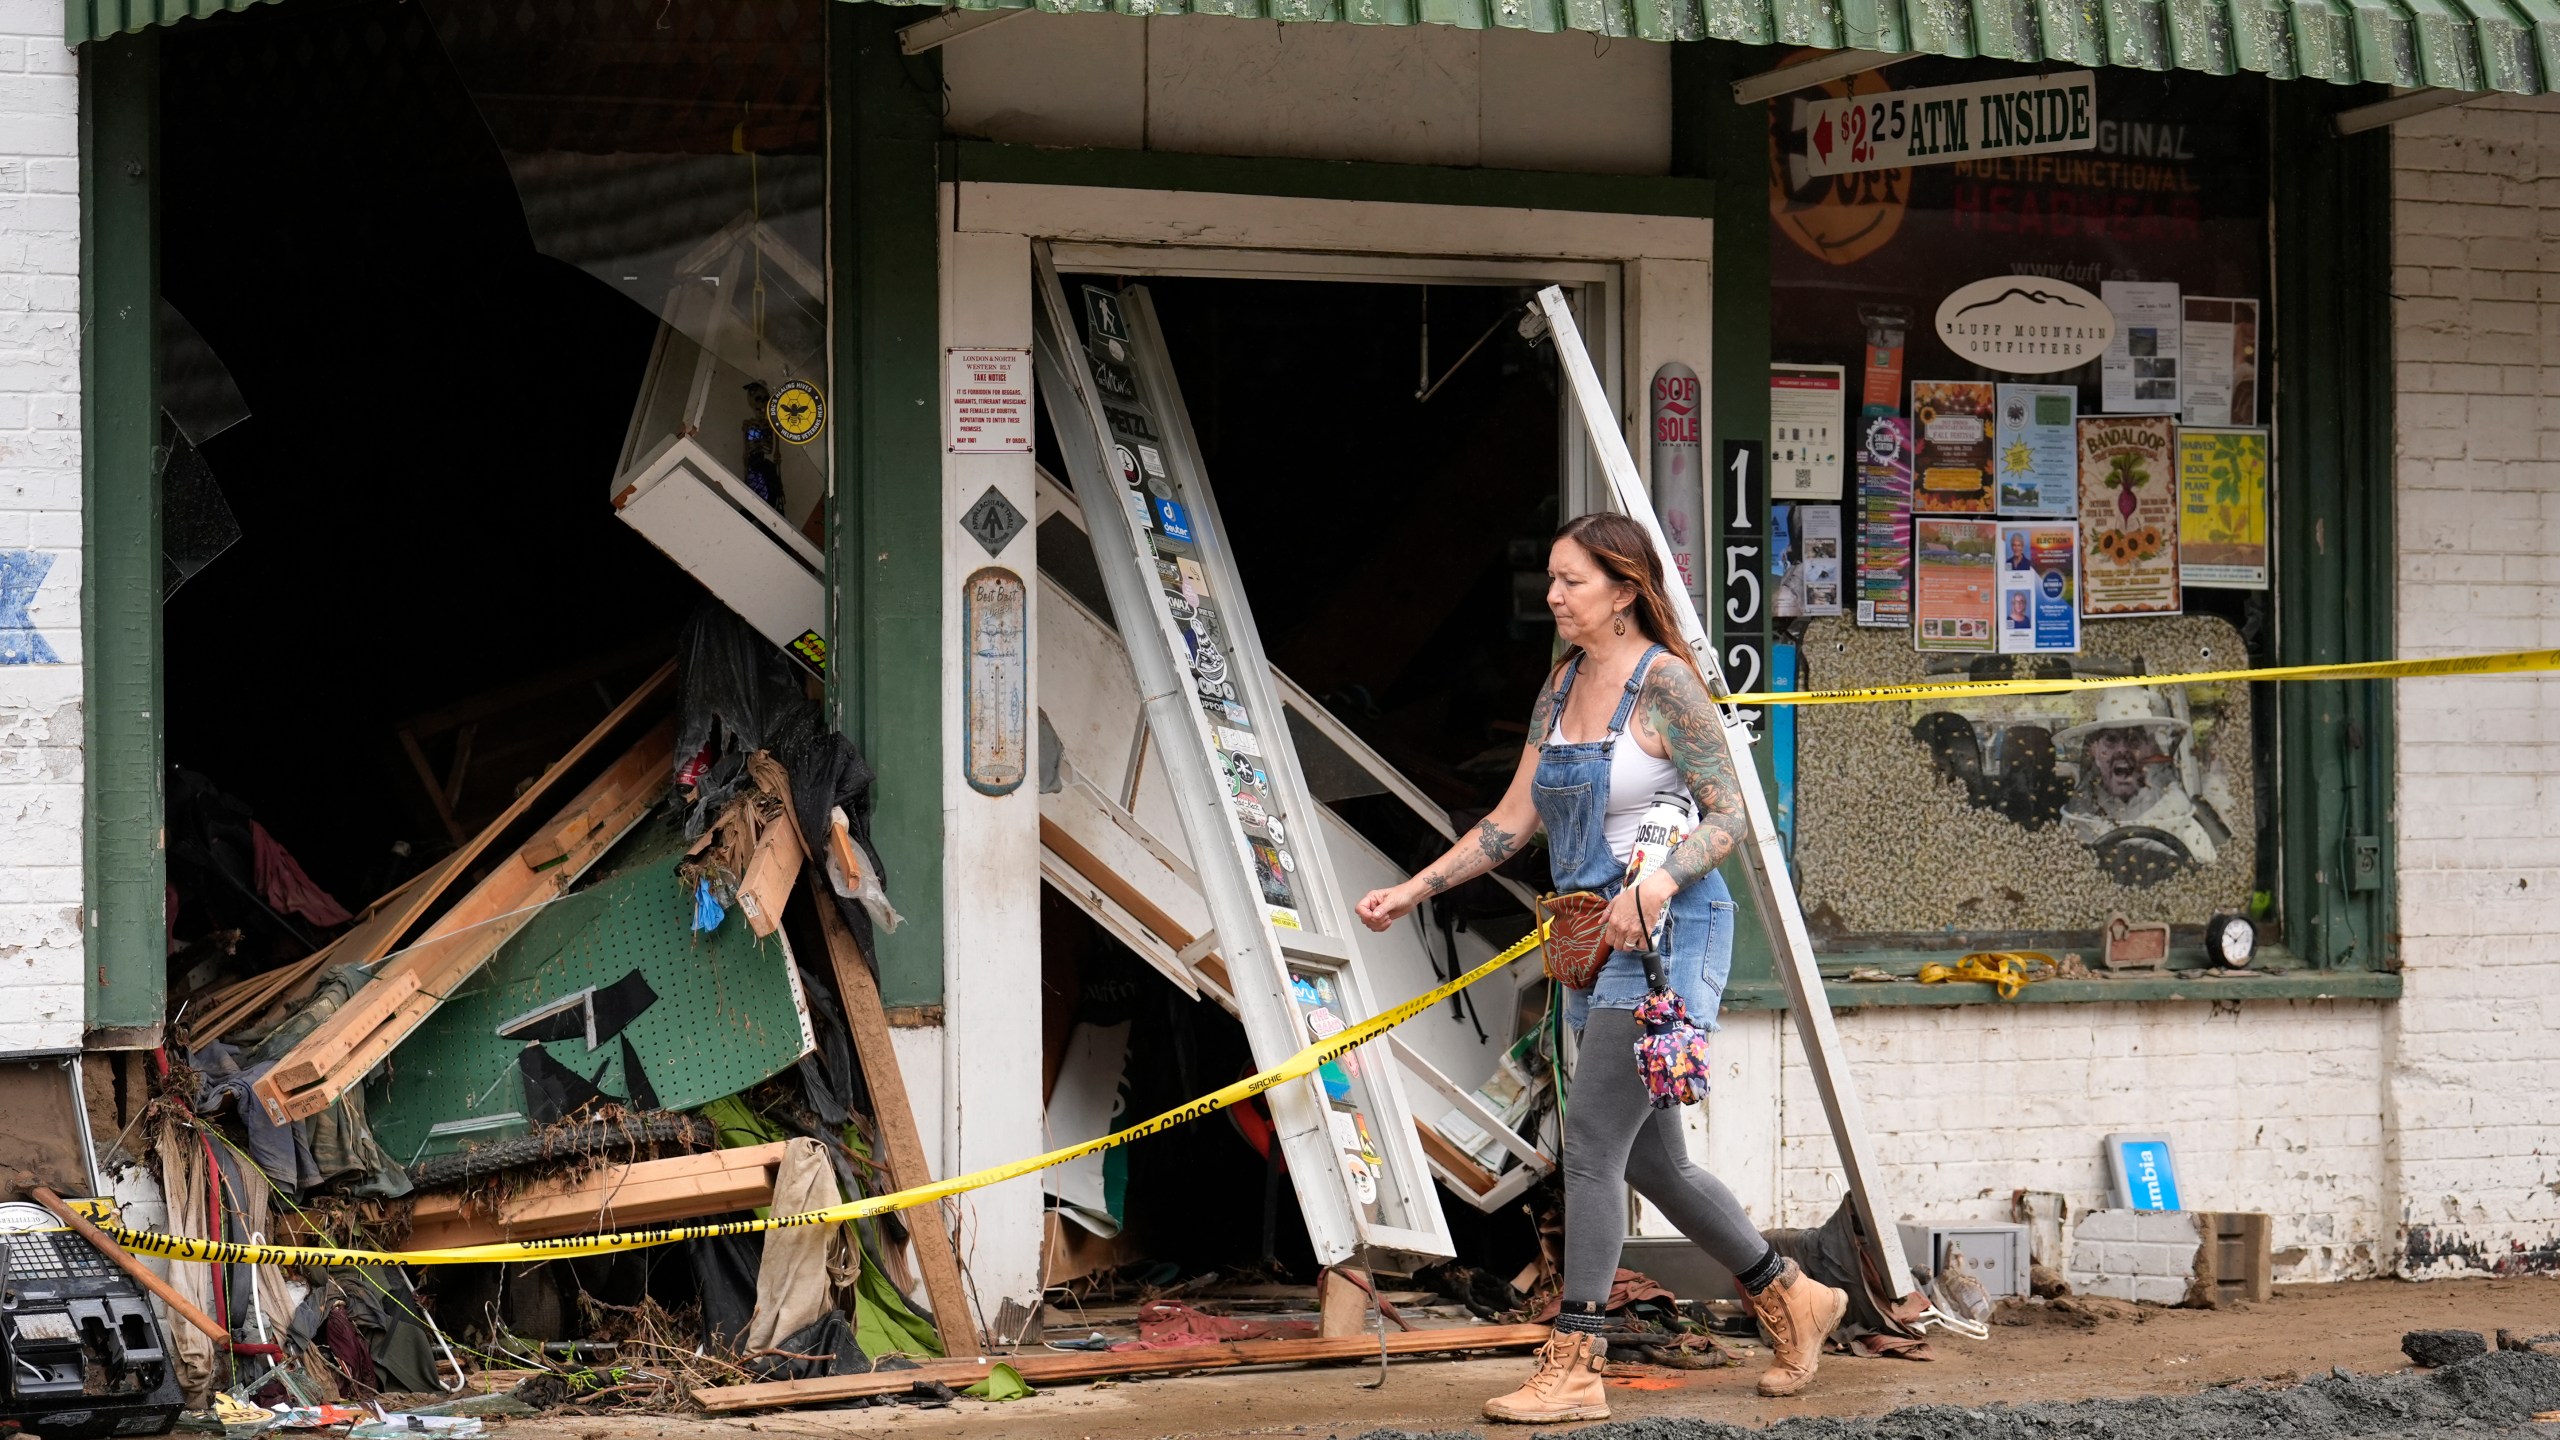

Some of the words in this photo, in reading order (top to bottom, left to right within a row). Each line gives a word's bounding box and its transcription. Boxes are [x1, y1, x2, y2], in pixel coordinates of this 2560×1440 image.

[1908, 98, 1969, 157] ATM
[1981, 85, 2090, 149] INSIDE
[2099, 119, 2195, 160] GINAL
[1954, 156, 2200, 192] MULTIFUNCTIONAL
[1954, 184, 2199, 242] HEADWEAR
[2015, 325, 2106, 339] MOUNTAIN
[1970, 340, 2082, 355] OUTFITTERS
[974, 373, 987, 382] TAKE
[988, 373, 1007, 382] NOTICE
[1656, 376, 1698, 401] SOF
[770, 399, 778, 416] DOC'S
[775, 382, 796, 399] HEALING
[796, 382, 813, 393] HIVES
[780, 428, 801, 441] HELPING
[801, 419, 822, 440] VETERANS
[1656, 416, 1698, 442] SOLE
[2086, 428, 2166, 455] BANDALOOP
[2181, 440, 2217, 450] HARVEST
[2190, 453, 2204, 462] THE
[2184, 481, 2210, 491] PLANT
[972, 499, 1006, 530] APPALACHIAN
[1004, 507, 1015, 530] TRAIL
[1163, 521, 1188, 536] deuter
[976, 586, 996, 602] Best
[1200, 699, 1226, 713] UPPOR
[1294, 987, 1317, 1001] AVU
[1248, 1072, 1283, 1092] SIRCHIE
[861, 1202, 899, 1217] SIRCHIE
[109, 1226, 197, 1259] ERIFF'S
[201, 1240, 250, 1264] LINE
[256, 1247, 287, 1265] DO
[292, 1250, 336, 1266] NOT
